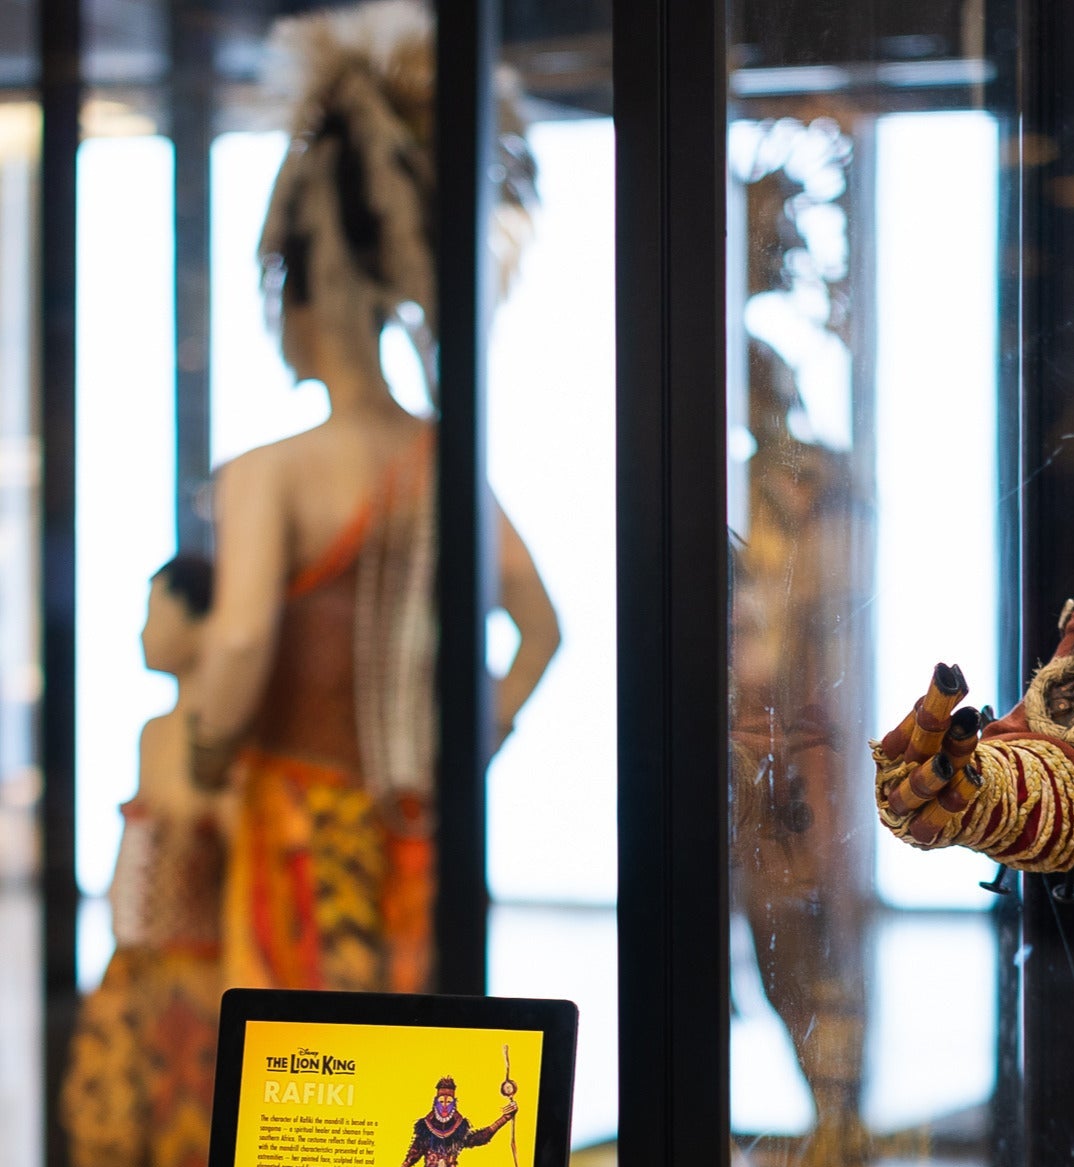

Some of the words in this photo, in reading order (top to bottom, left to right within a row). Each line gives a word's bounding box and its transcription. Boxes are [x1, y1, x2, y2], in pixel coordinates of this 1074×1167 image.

[297, 1048, 319, 1058] Disney
[266, 1056, 288, 1069] THE
[290, 1054, 320, 1074] LION
[322, 1055, 356, 1075] KING
[264, 1081, 355, 1106] RAFIKI
